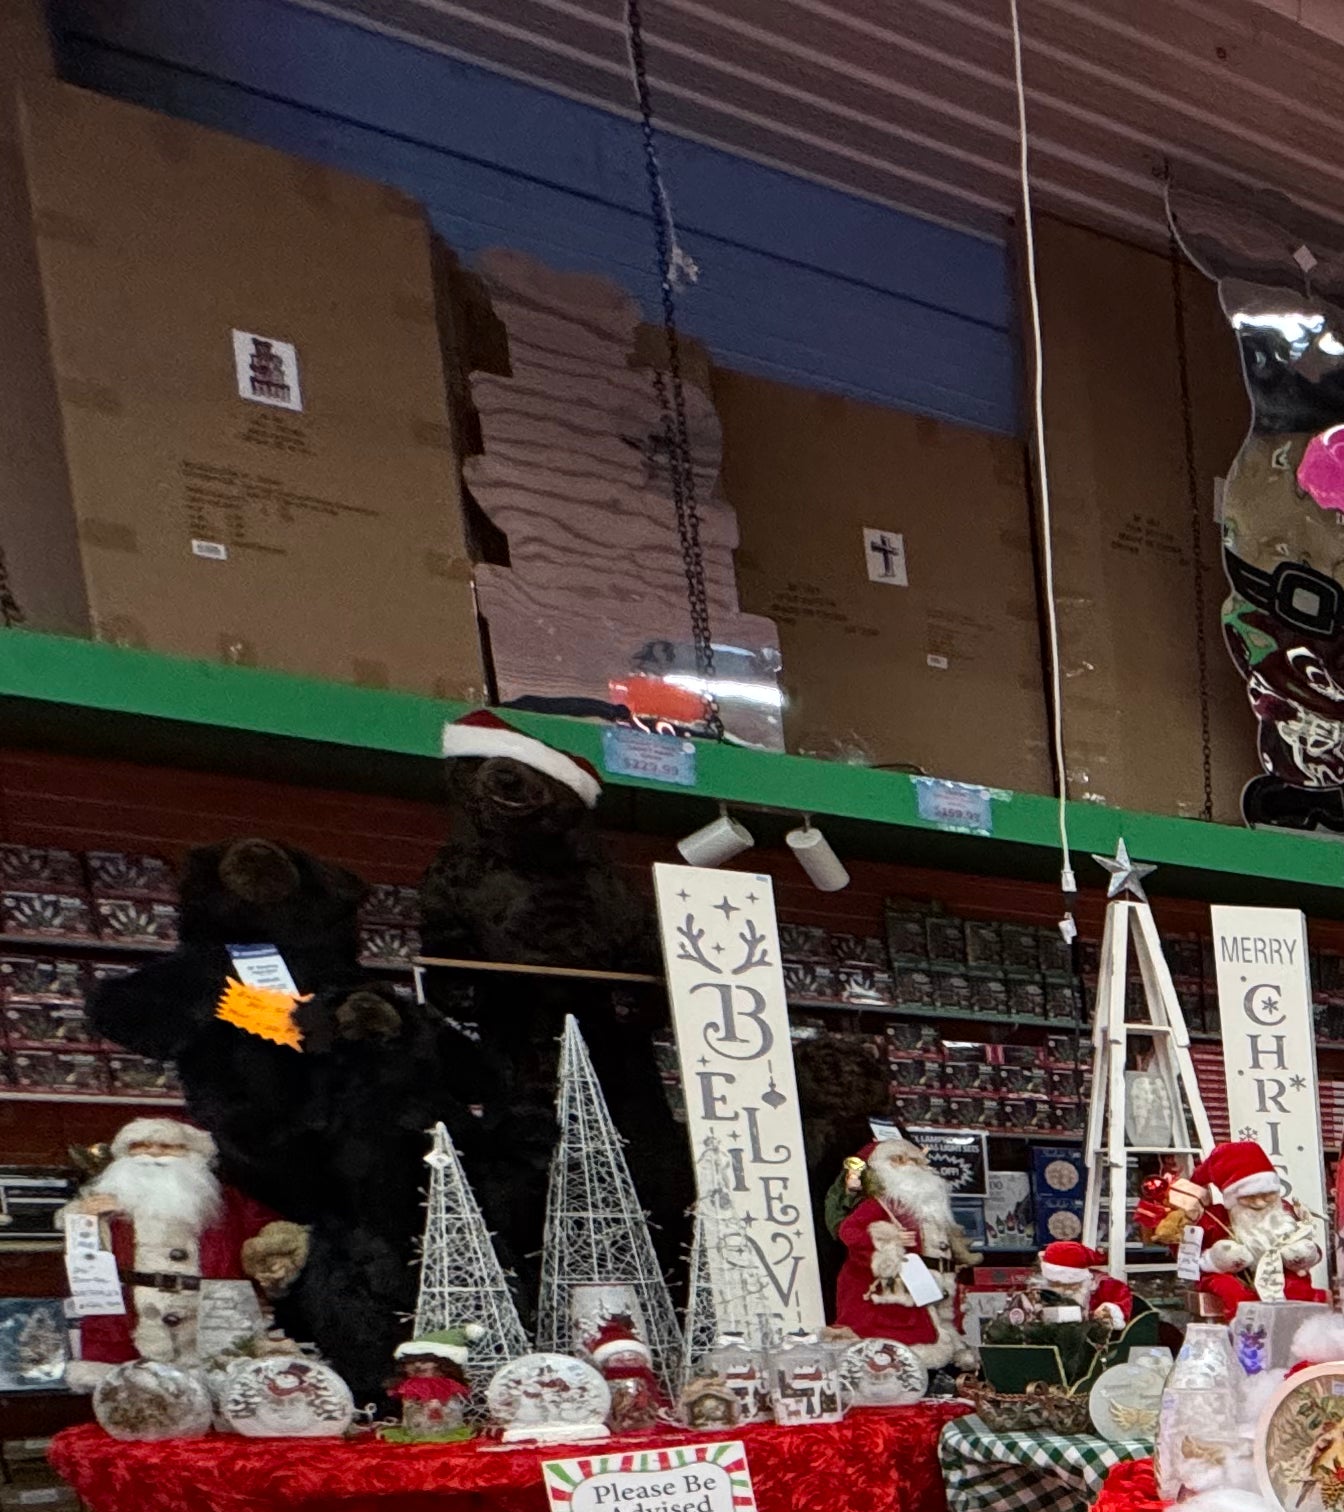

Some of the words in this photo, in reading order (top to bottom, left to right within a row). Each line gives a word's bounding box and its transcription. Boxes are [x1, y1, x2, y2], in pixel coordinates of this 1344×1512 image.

[1221, 936, 1296, 965] MERRY
[1243, 983, 1293, 1198] CHRIS
[592, 1482, 676, 1504] Please
[682, 1475, 717, 1493] Be
